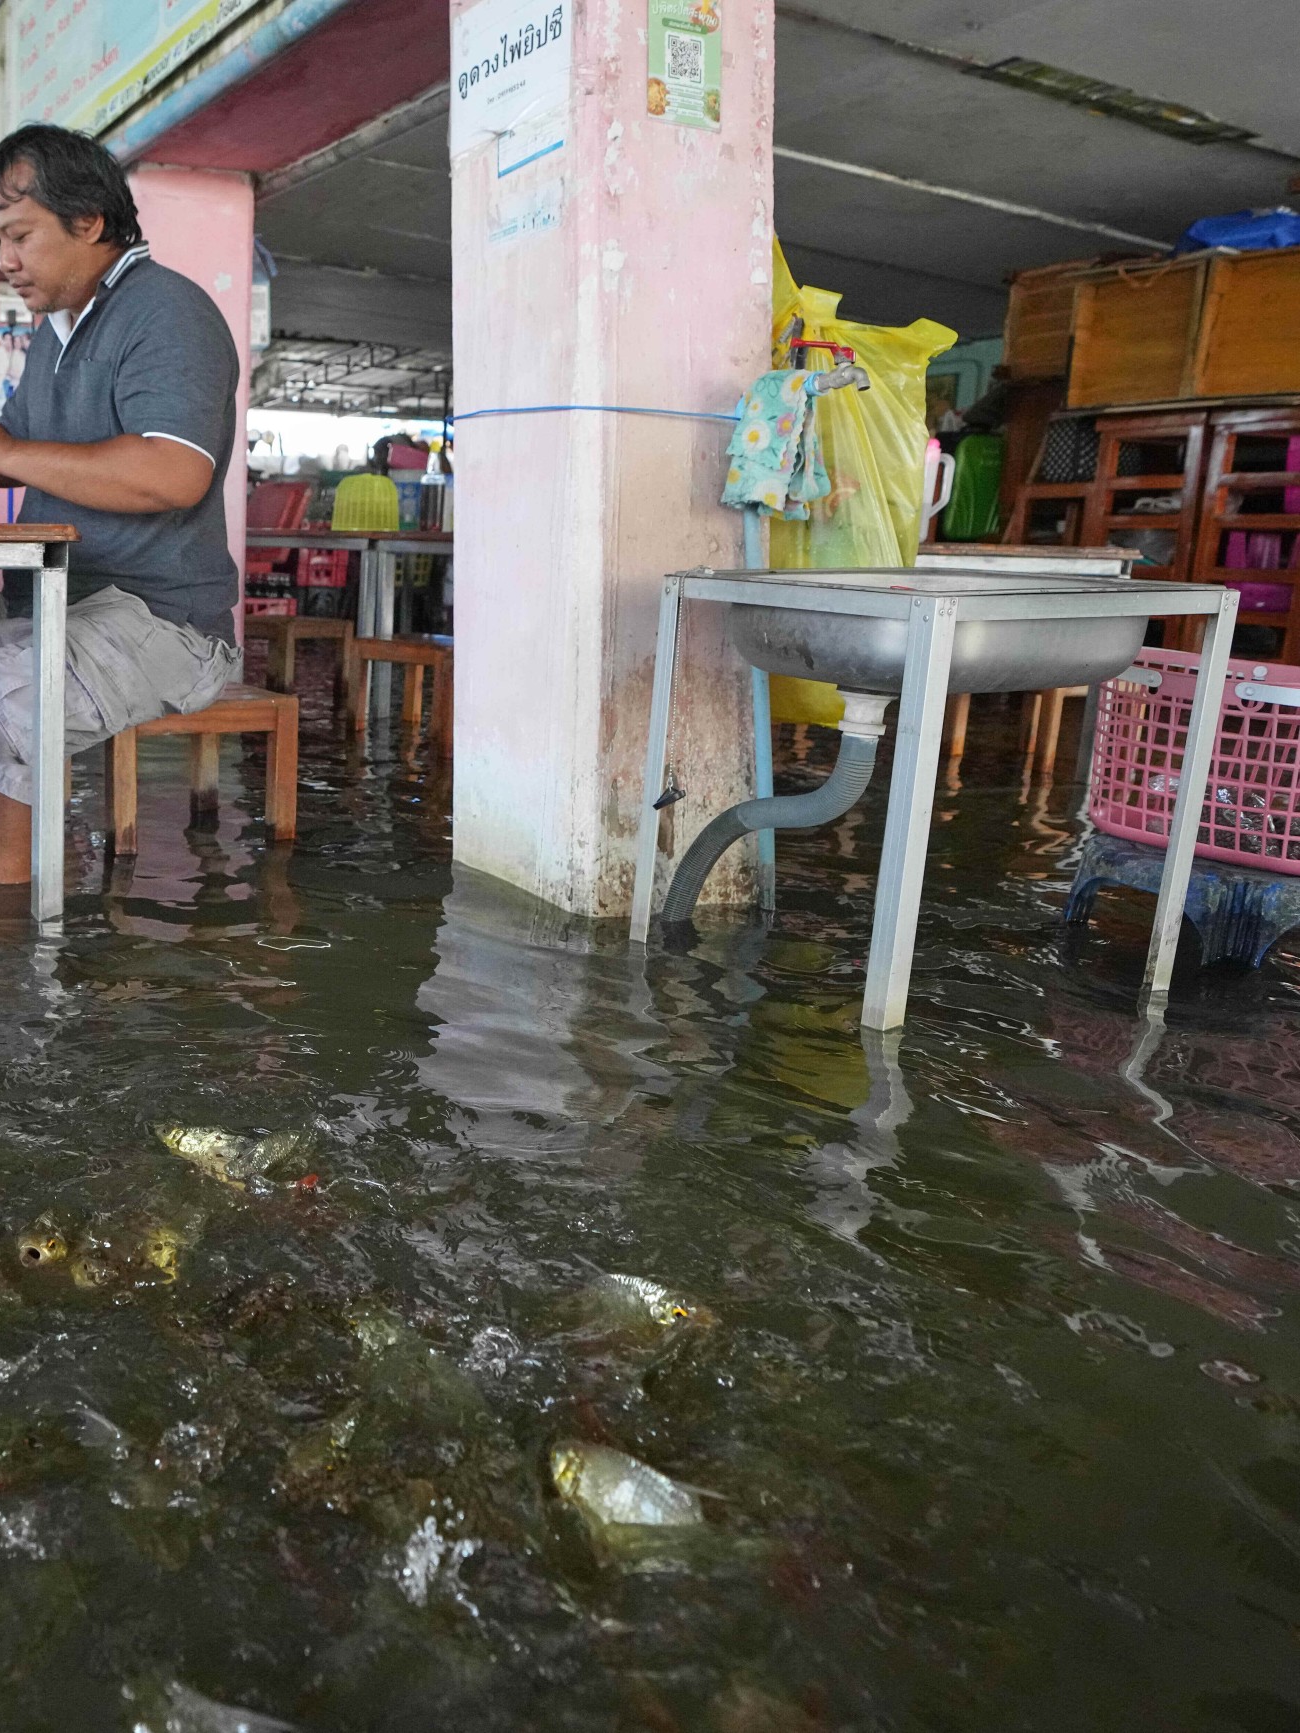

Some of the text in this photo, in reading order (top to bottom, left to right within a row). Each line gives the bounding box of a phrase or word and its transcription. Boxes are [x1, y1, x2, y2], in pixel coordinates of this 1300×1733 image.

[458, 4, 563, 100] ดูดวงไพ่ยิปซี
